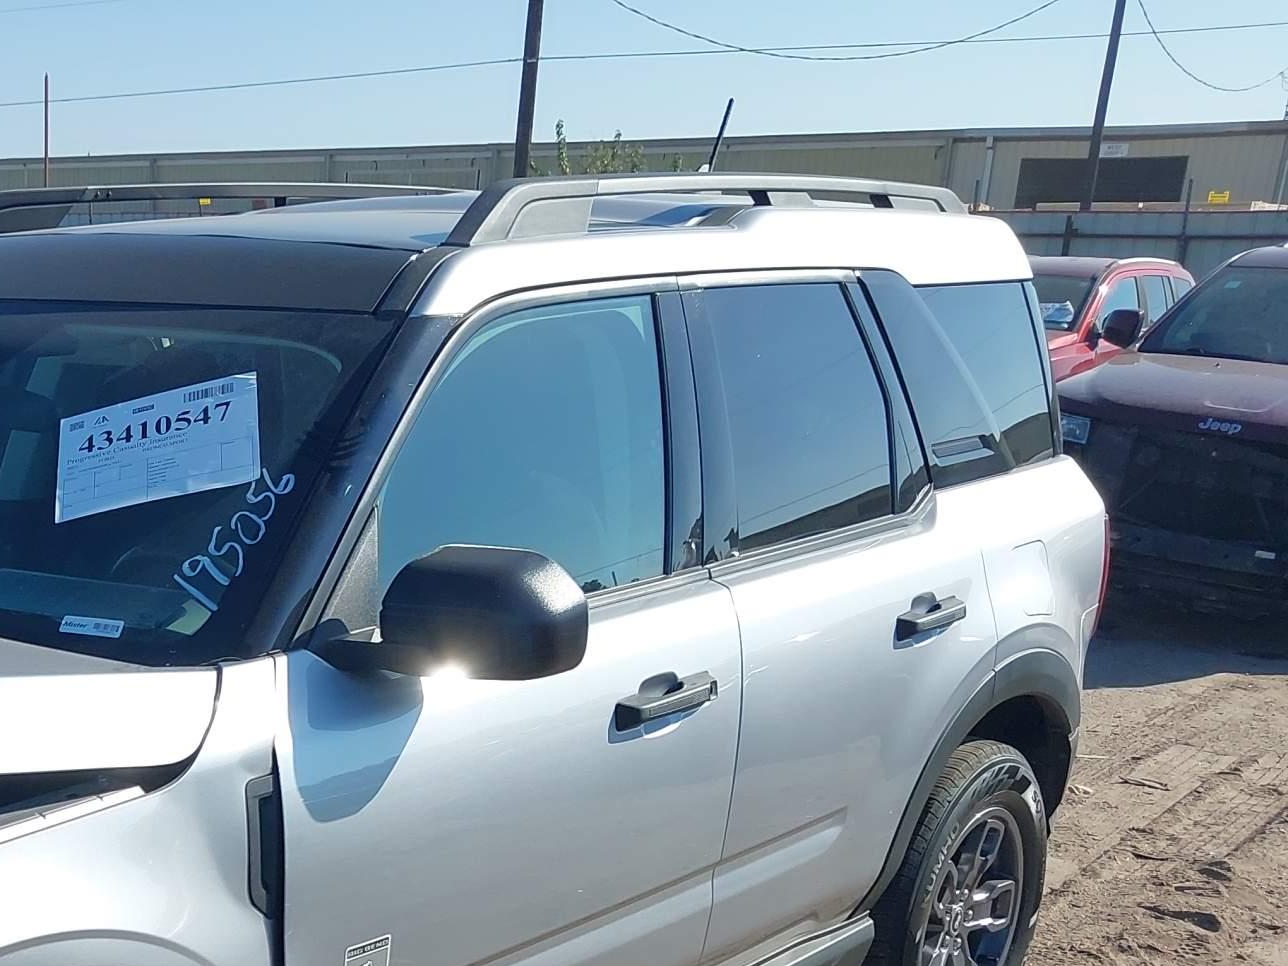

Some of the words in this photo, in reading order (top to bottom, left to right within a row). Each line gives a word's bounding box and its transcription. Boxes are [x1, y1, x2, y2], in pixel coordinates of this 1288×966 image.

[78, 400, 232, 453] 43410547
[1198, 418, 1242, 435] Jeep
[173, 467, 295, 611] 195056
